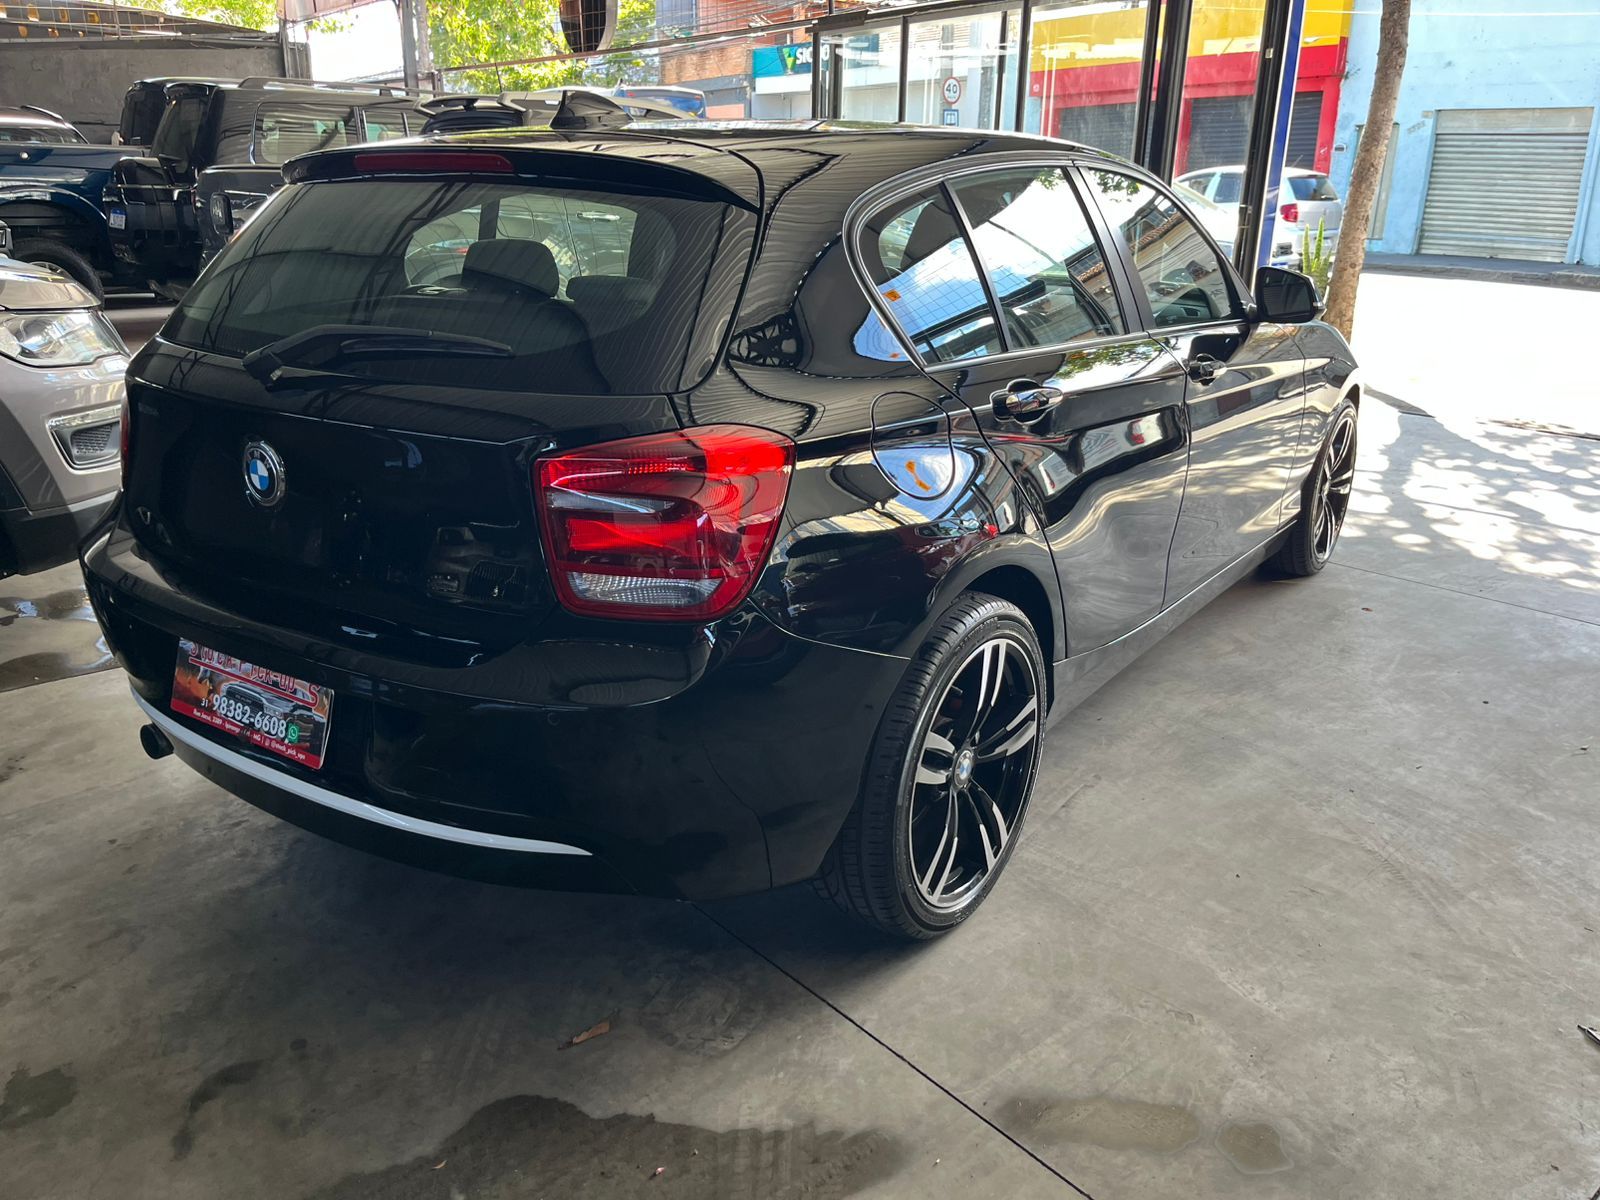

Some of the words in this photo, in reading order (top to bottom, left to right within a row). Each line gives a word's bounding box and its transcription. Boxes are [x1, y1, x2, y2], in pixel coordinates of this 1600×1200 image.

[945, 83, 958, 95] 40
[201, 698, 209, 708] 31
[212, 694, 287, 738] 98382-6608
